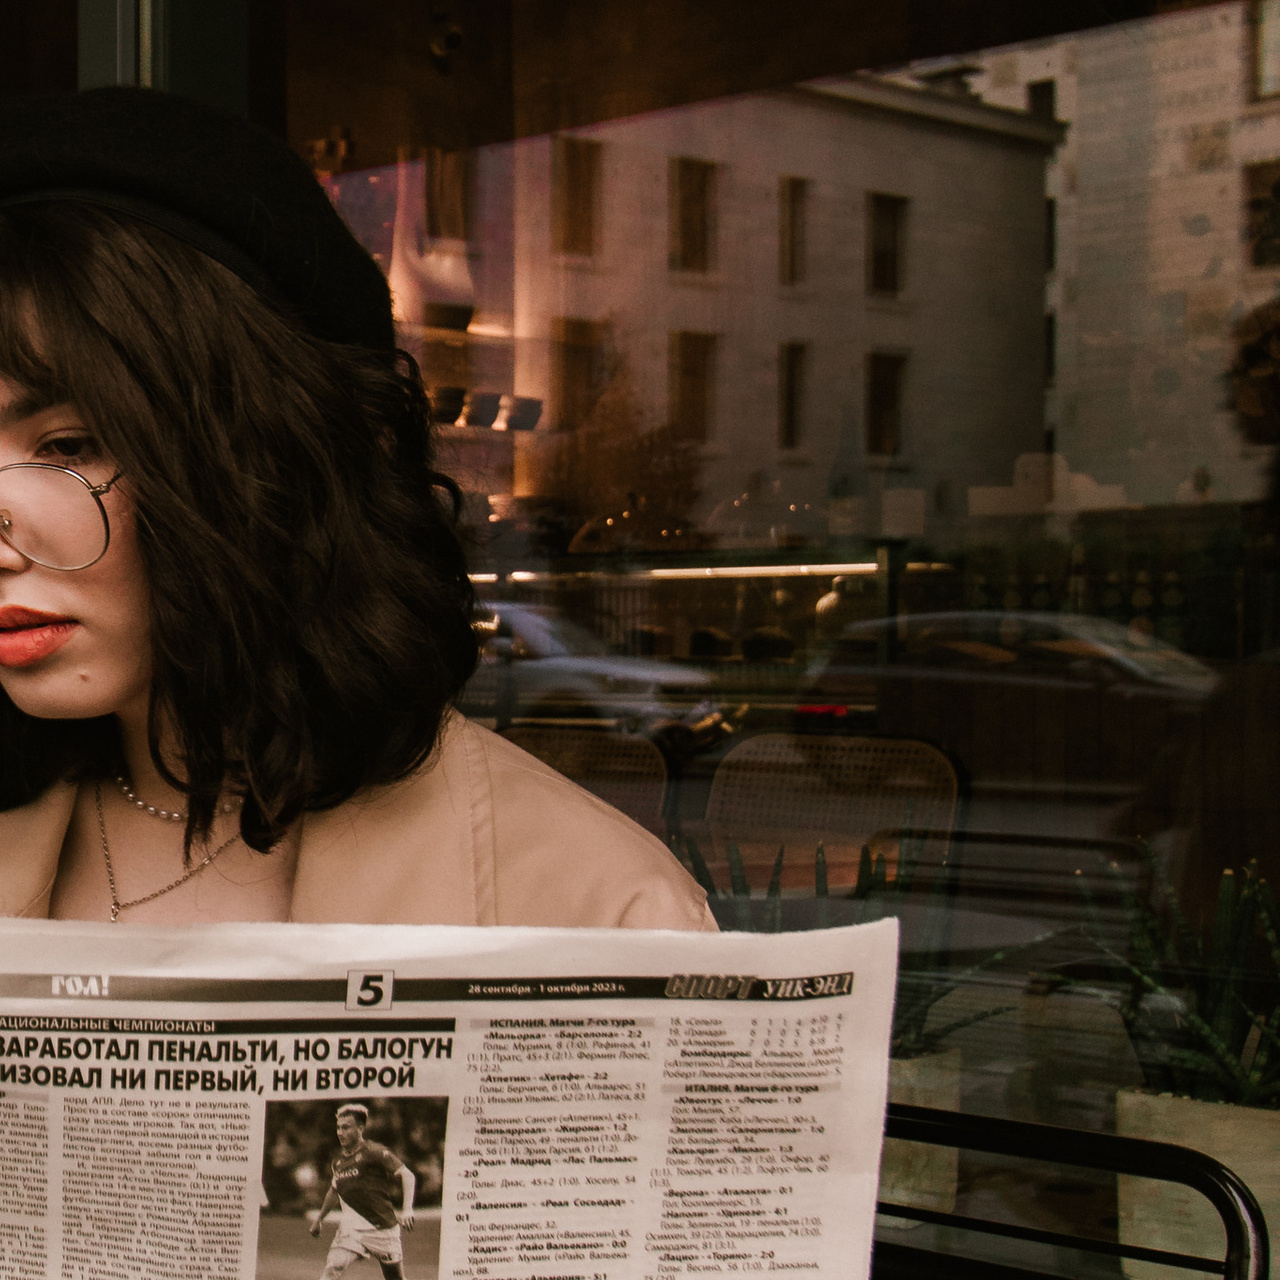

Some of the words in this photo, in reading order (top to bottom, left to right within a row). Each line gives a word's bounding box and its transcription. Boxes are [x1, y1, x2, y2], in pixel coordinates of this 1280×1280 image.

[52, 974, 110, 997] ГОЛ!
[356, 973, 384, 1007] 5
[468, 984, 481, 994] 28
[483, 984, 531, 997] сентября
[547, 983, 590, 997] октября
[592, 982, 617, 993] 2023
[113, 1018, 216, 1033] ЧЕМПИОНАТЫ
[148, 1038, 286, 1067] ПЕНАЛЬТИ,
[293, 1038, 331, 1062] НО
[338, 1036, 454, 1060] БАЛОГУН
[109, 1067, 147, 1090] НИ
[154, 1064, 265, 1095] ПЕРВЫЙ,
[272, 1067, 309, 1092] НИ
[315, 1061, 417, 1091] ВТОРОЙ
